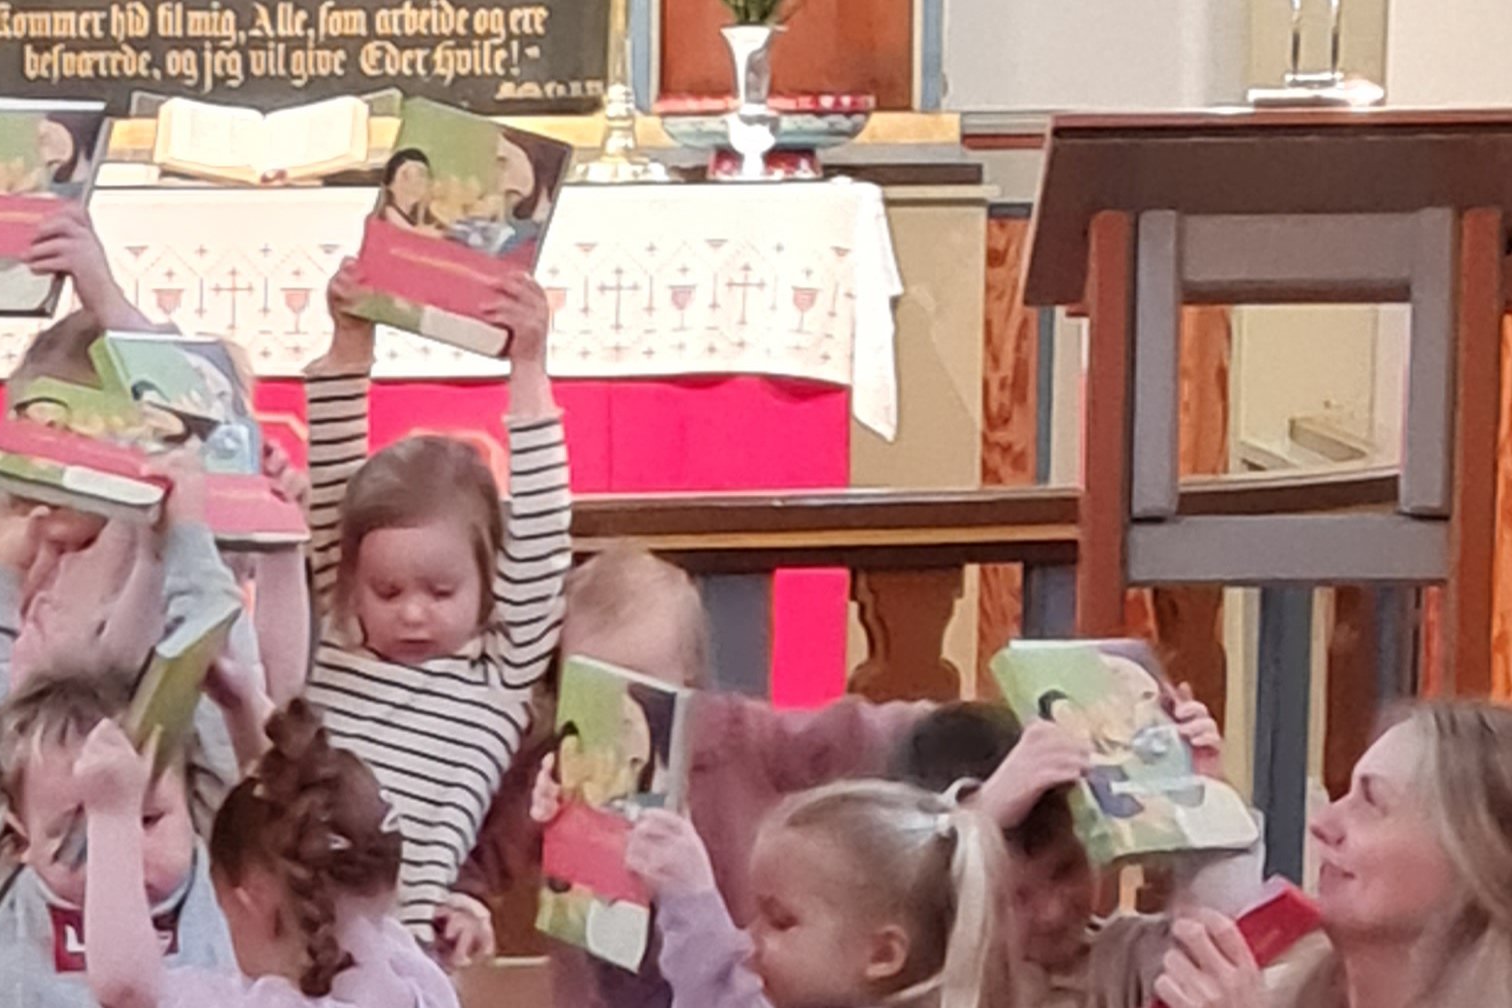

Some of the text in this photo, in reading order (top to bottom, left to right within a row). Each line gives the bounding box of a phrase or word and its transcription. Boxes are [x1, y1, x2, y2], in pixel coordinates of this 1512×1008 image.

[110, 1, 150, 42] hid
[157, 1, 183, 38] til
[186, 1, 246, 47] mig,
[248, 1, 317, 44] Alle,
[375, 0, 469, 37] arbeide
[473, 7, 506, 45] og
[509, 5, 550, 36] ere
[165, 48, 198, 86] og
[202, 41, 244, 93] jeg
[249, 42, 287, 77] vil
[290, 41, 347, 87] give
[359, 40, 430, 77] Eder
